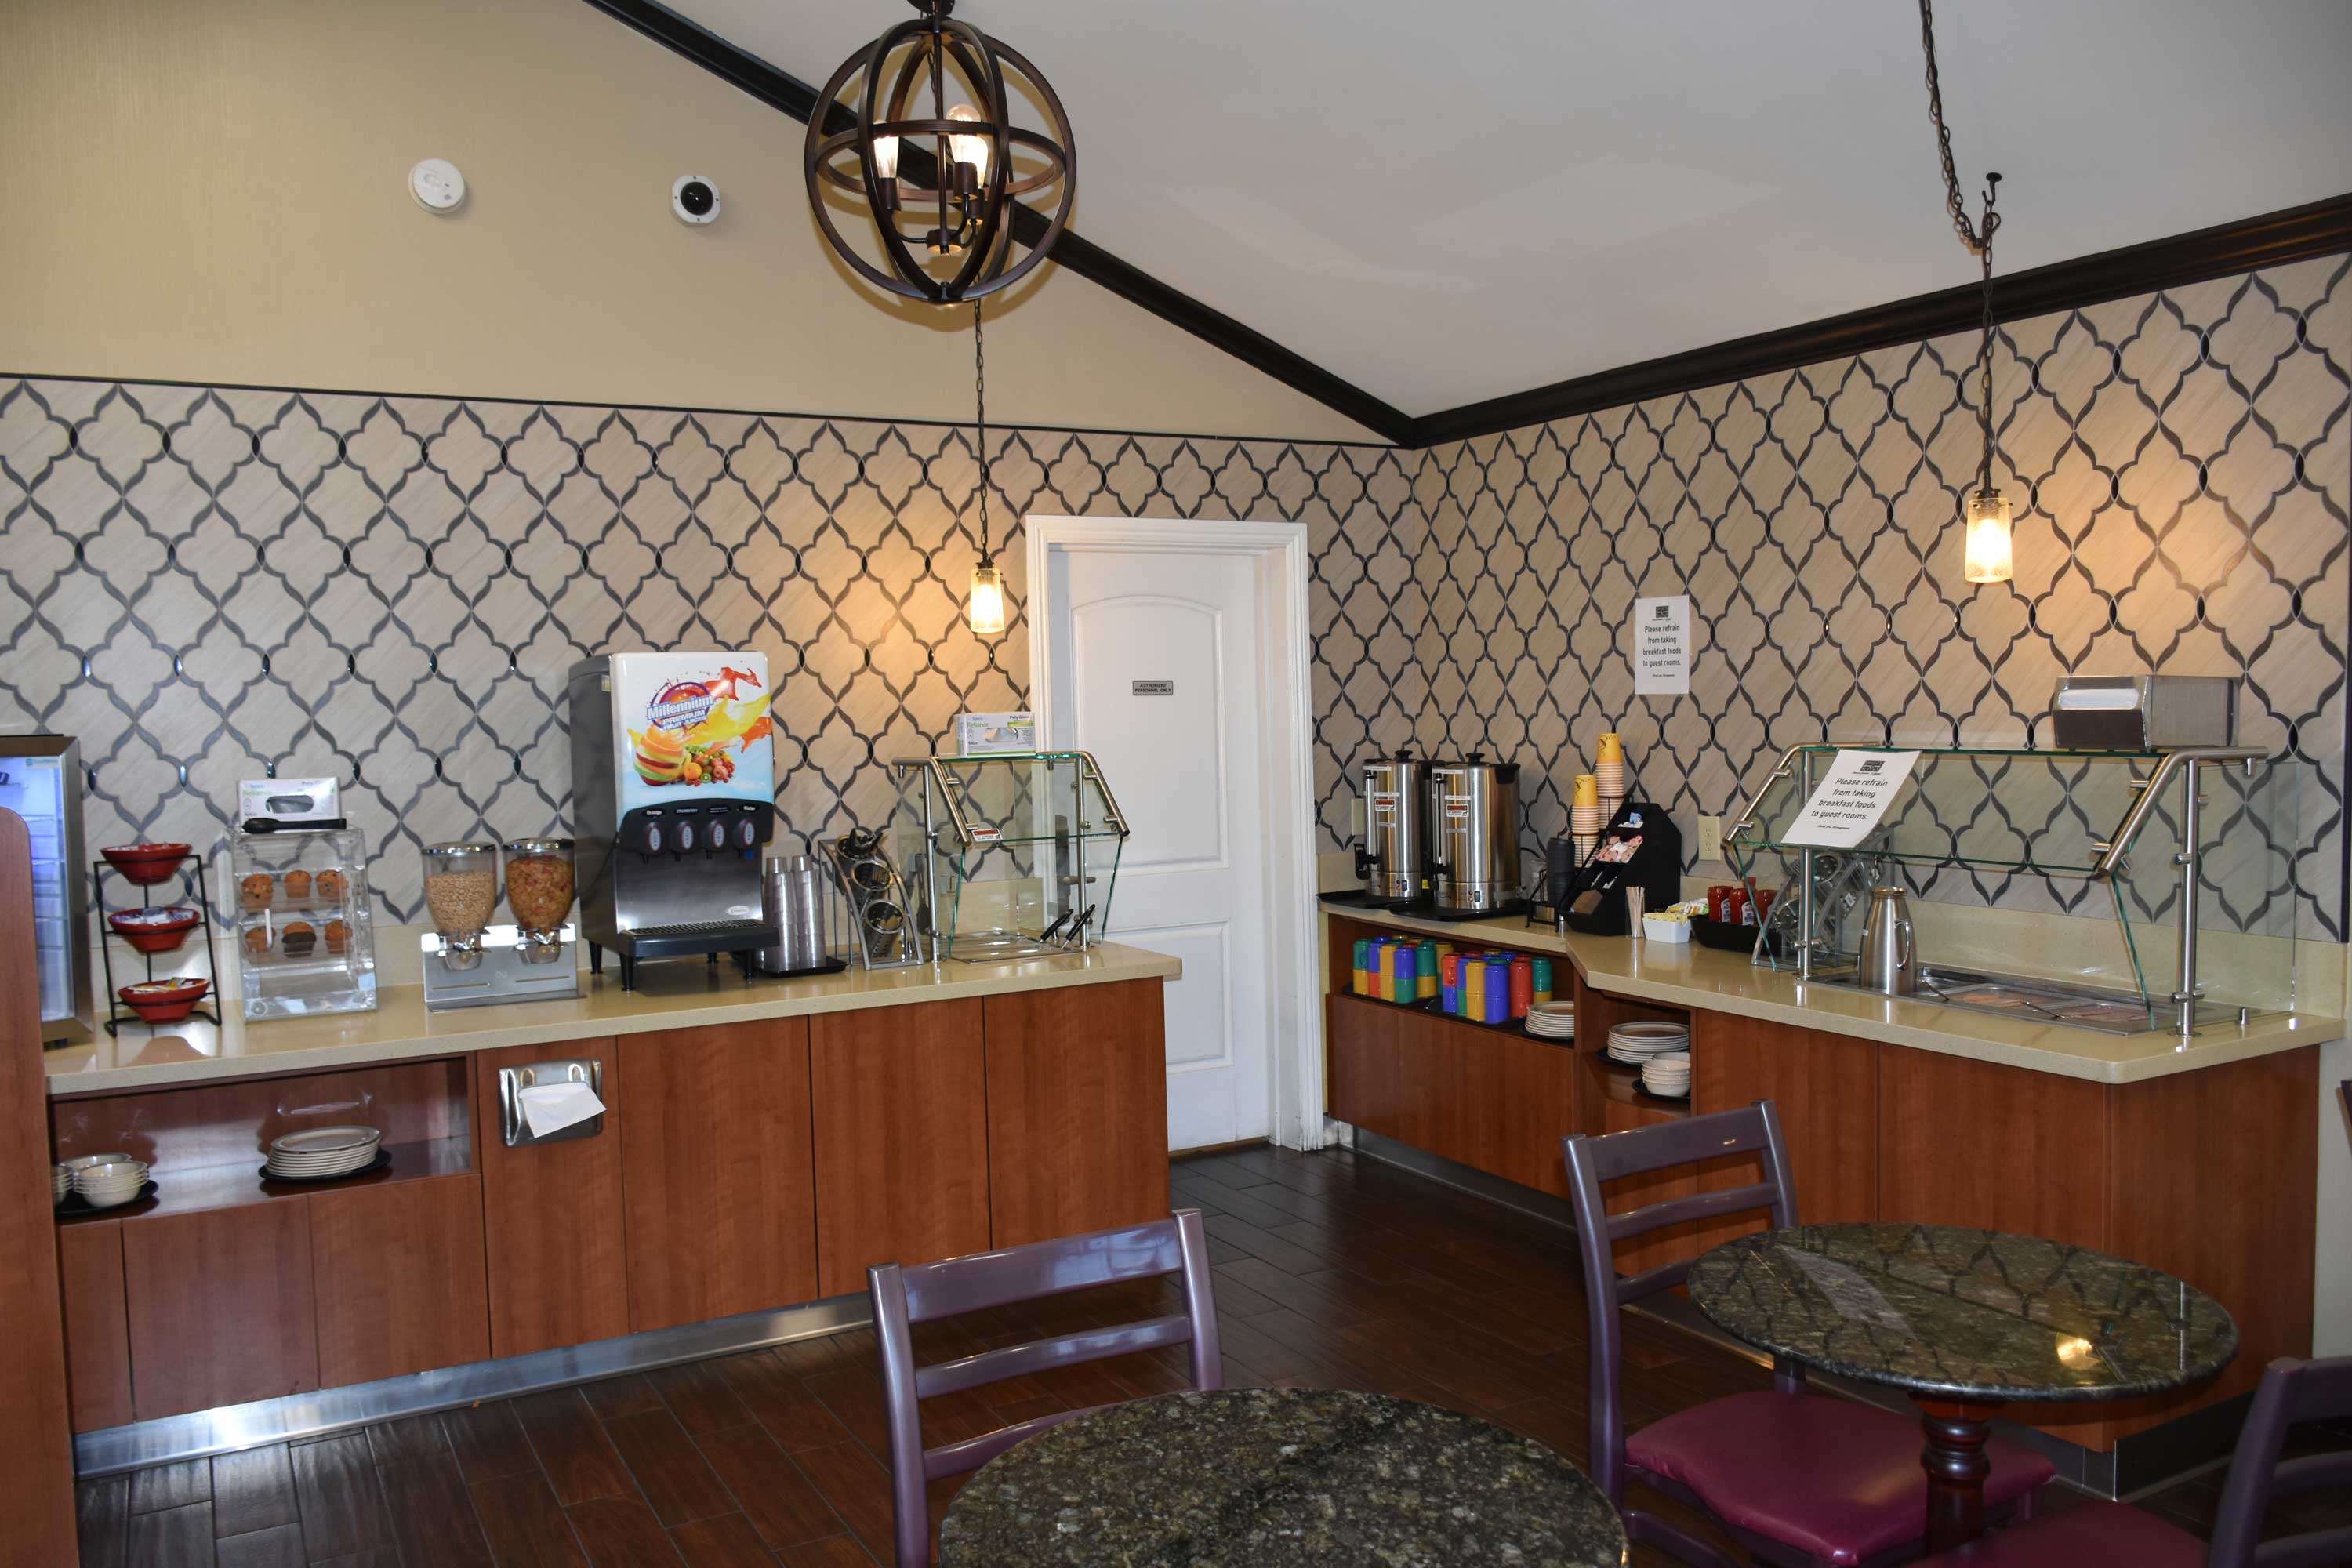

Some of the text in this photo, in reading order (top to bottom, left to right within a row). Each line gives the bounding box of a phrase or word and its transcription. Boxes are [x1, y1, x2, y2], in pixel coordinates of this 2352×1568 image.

[1650, 659, 1663, 668] guest
[647, 695, 714, 720] Millennium
[664, 710, 706, 724] PREMIUM
[1818, 799, 1854, 808] breakfast
